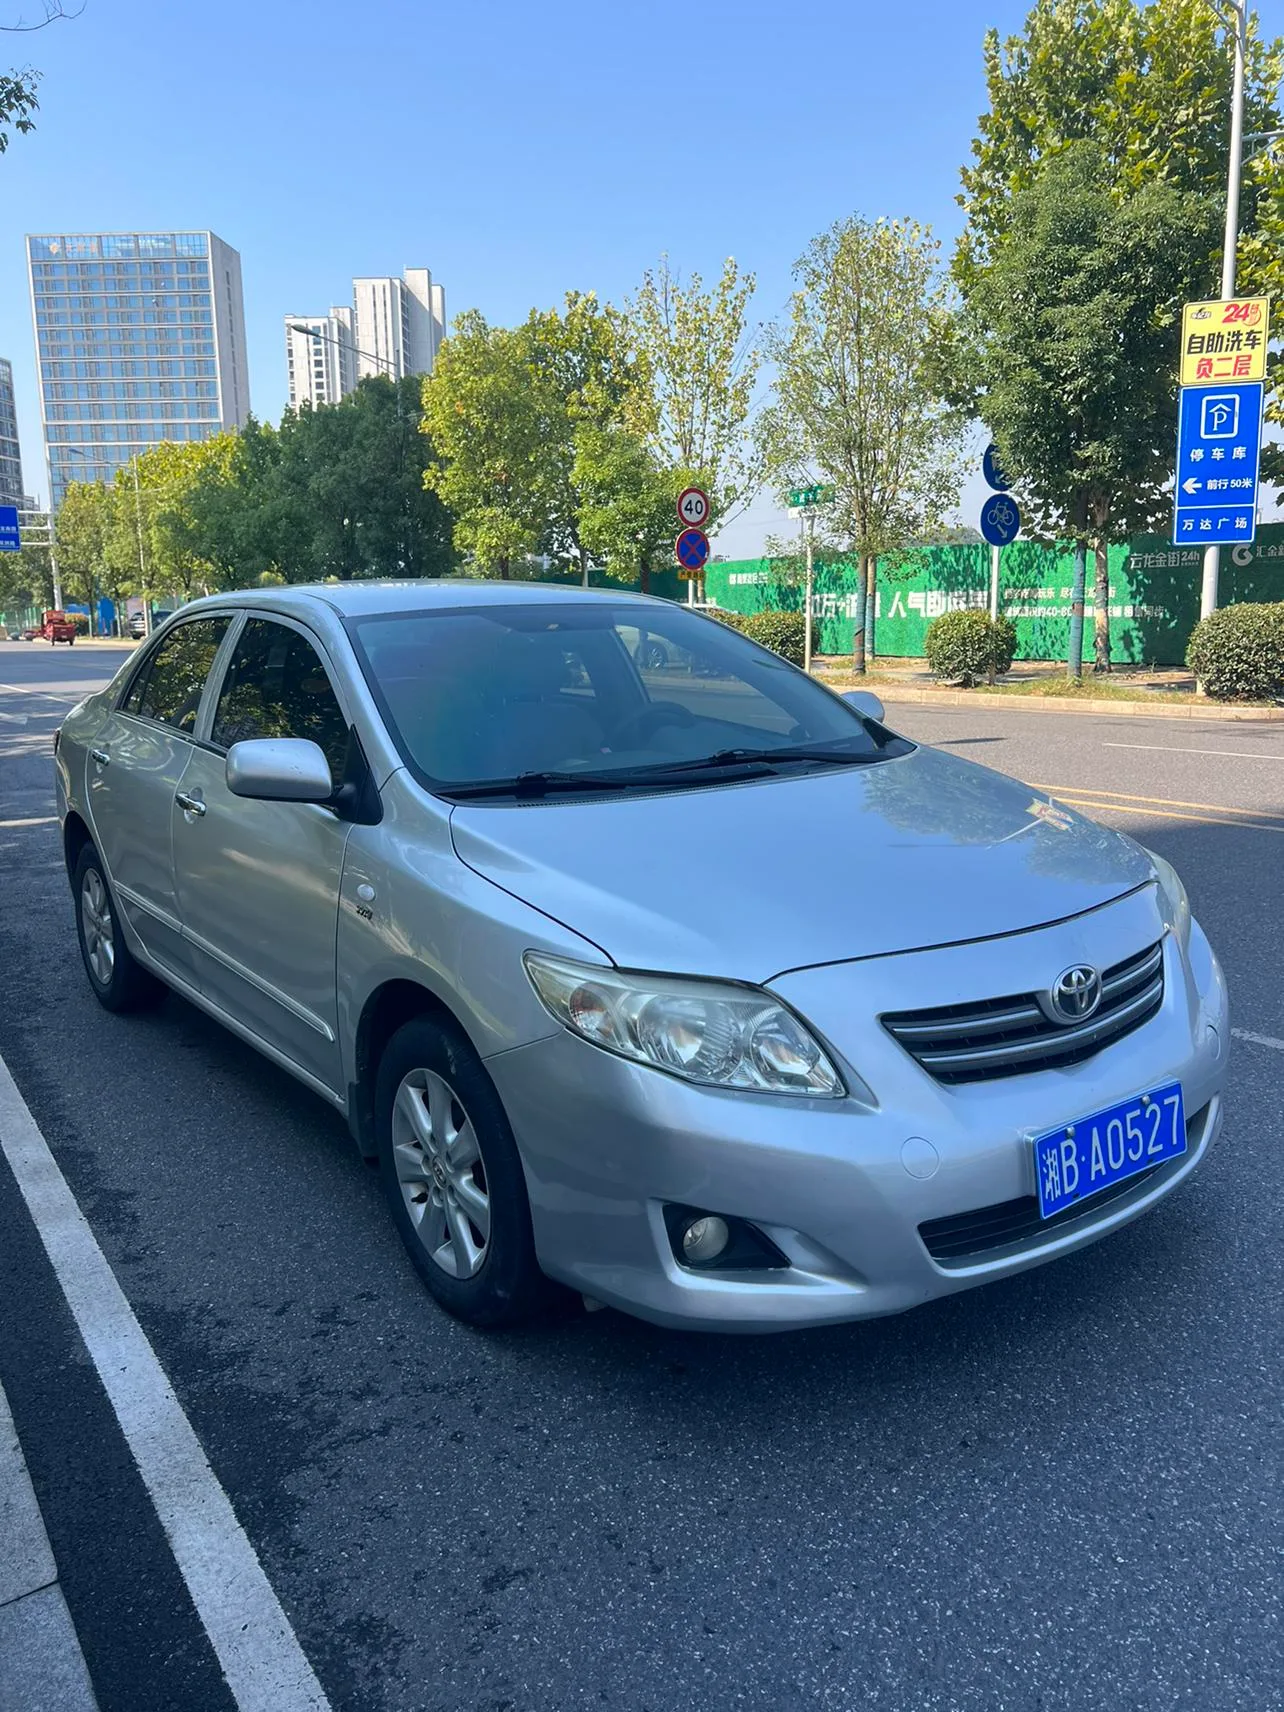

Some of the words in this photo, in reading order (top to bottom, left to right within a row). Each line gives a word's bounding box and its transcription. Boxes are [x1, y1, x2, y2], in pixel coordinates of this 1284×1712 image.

[1222, 303, 1251, 324] 24
[1187, 330, 1263, 355] 自助洗车
[1196, 354, 1252, 379] 负二层
[1190, 446, 1247, 462] 停车库
[684, 499, 703, 515] 40
[1182, 517, 1248, 531] 万达广场
[1042, 1094, 1180, 1201] 湘B·A0527
